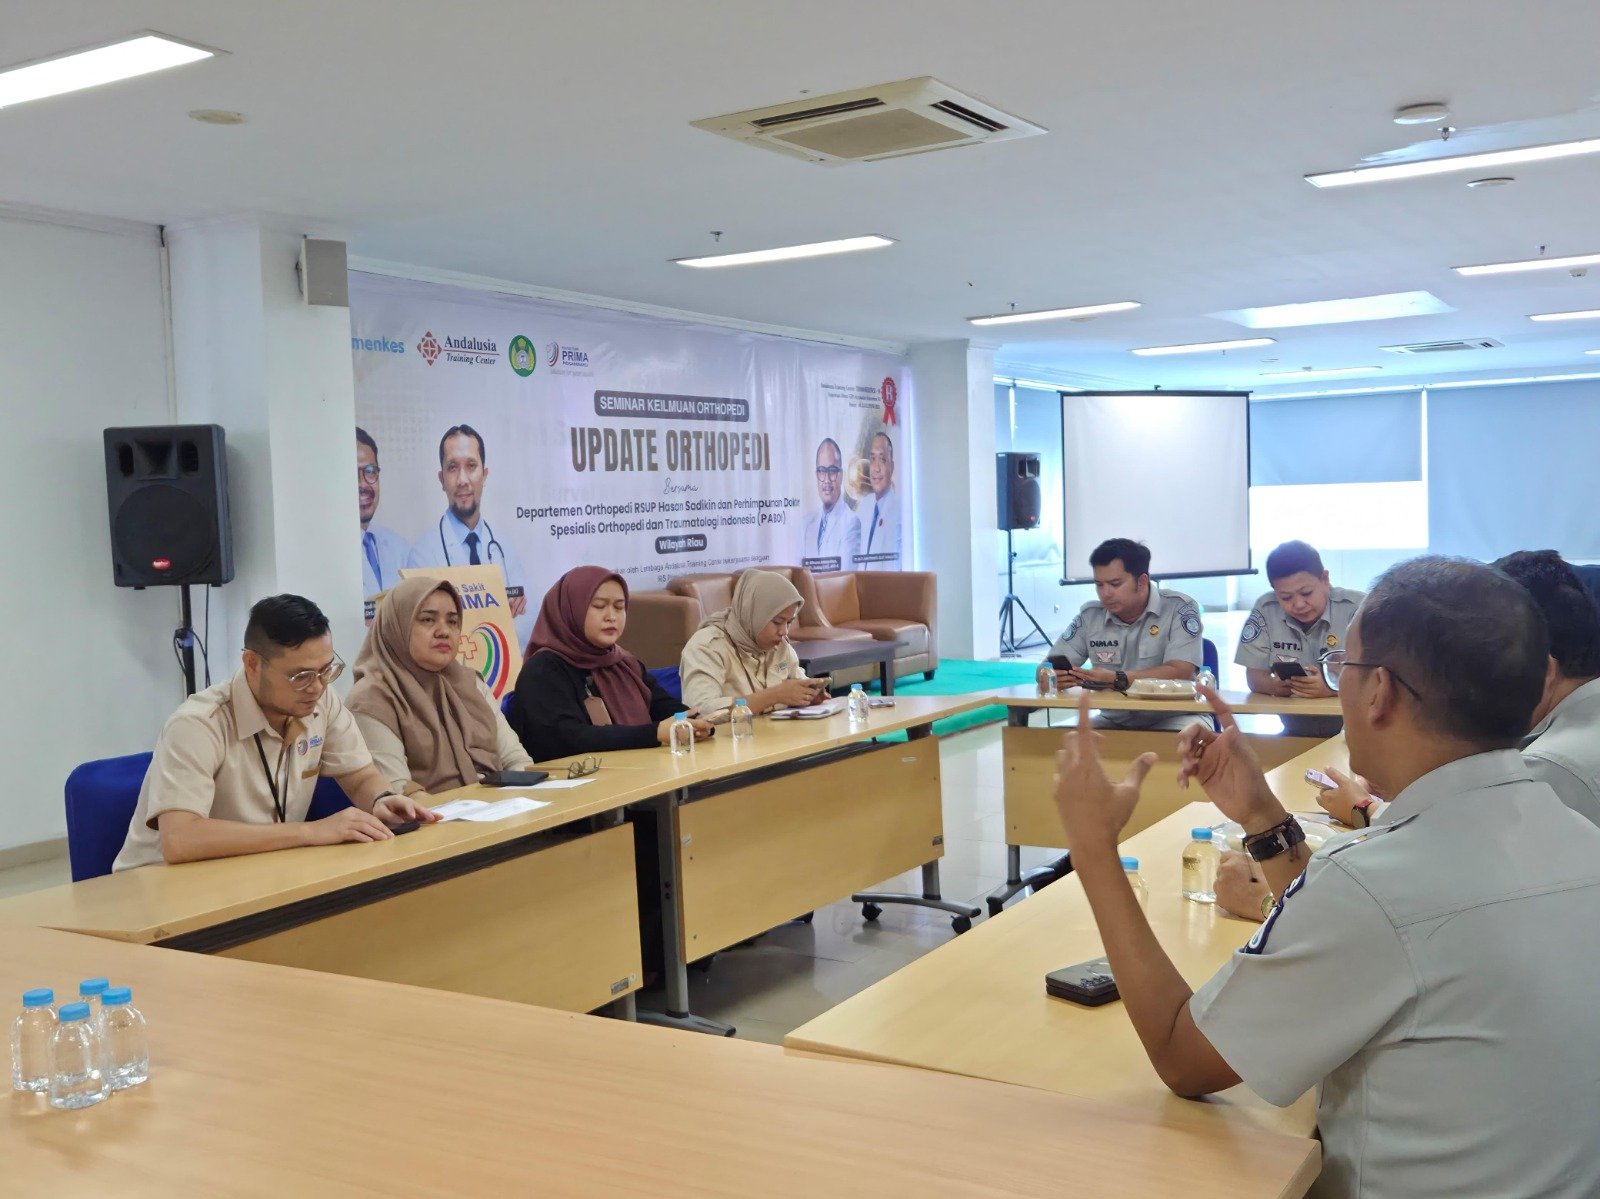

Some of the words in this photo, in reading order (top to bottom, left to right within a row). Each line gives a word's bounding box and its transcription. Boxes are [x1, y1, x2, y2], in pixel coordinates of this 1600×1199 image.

[351, 336, 405, 353] menkes
[444, 336, 497, 352] Andalusia
[446, 353, 473, 365] Training
[475, 355, 496, 365] Center
[562, 350, 589, 362] PRIMA
[600, 396, 645, 411] SEMINAR
[647, 399, 696, 413] KEILMUAN
[697, 402, 745, 416] ORTHOPEDI
[570, 427, 659, 473] UPDATE
[665, 429, 771, 472] ORTHOPEDI
[663, 477, 698, 495] Bersama
[516, 505, 583, 521] Departemen
[585, 502, 633, 518] Orthopedi
[634, 501, 657, 514] RSUP
[658, 500, 684, 512] Hasan
[685, 499, 716, 511] Sadikin
[717, 500, 733, 509] dan
[733, 498, 783, 512] Perhimpunan
[550, 522, 596, 539] Spesialis
[597, 519, 644, 535] Orthopedi
[645, 518, 664, 530] dan
[665, 516, 718, 530] Traumatologi
[659, 539, 686, 551] Wilayah
[687, 537, 704, 548] Riau
[461, 582, 486, 593] Sakit
[458, 592, 500, 610] IMA
